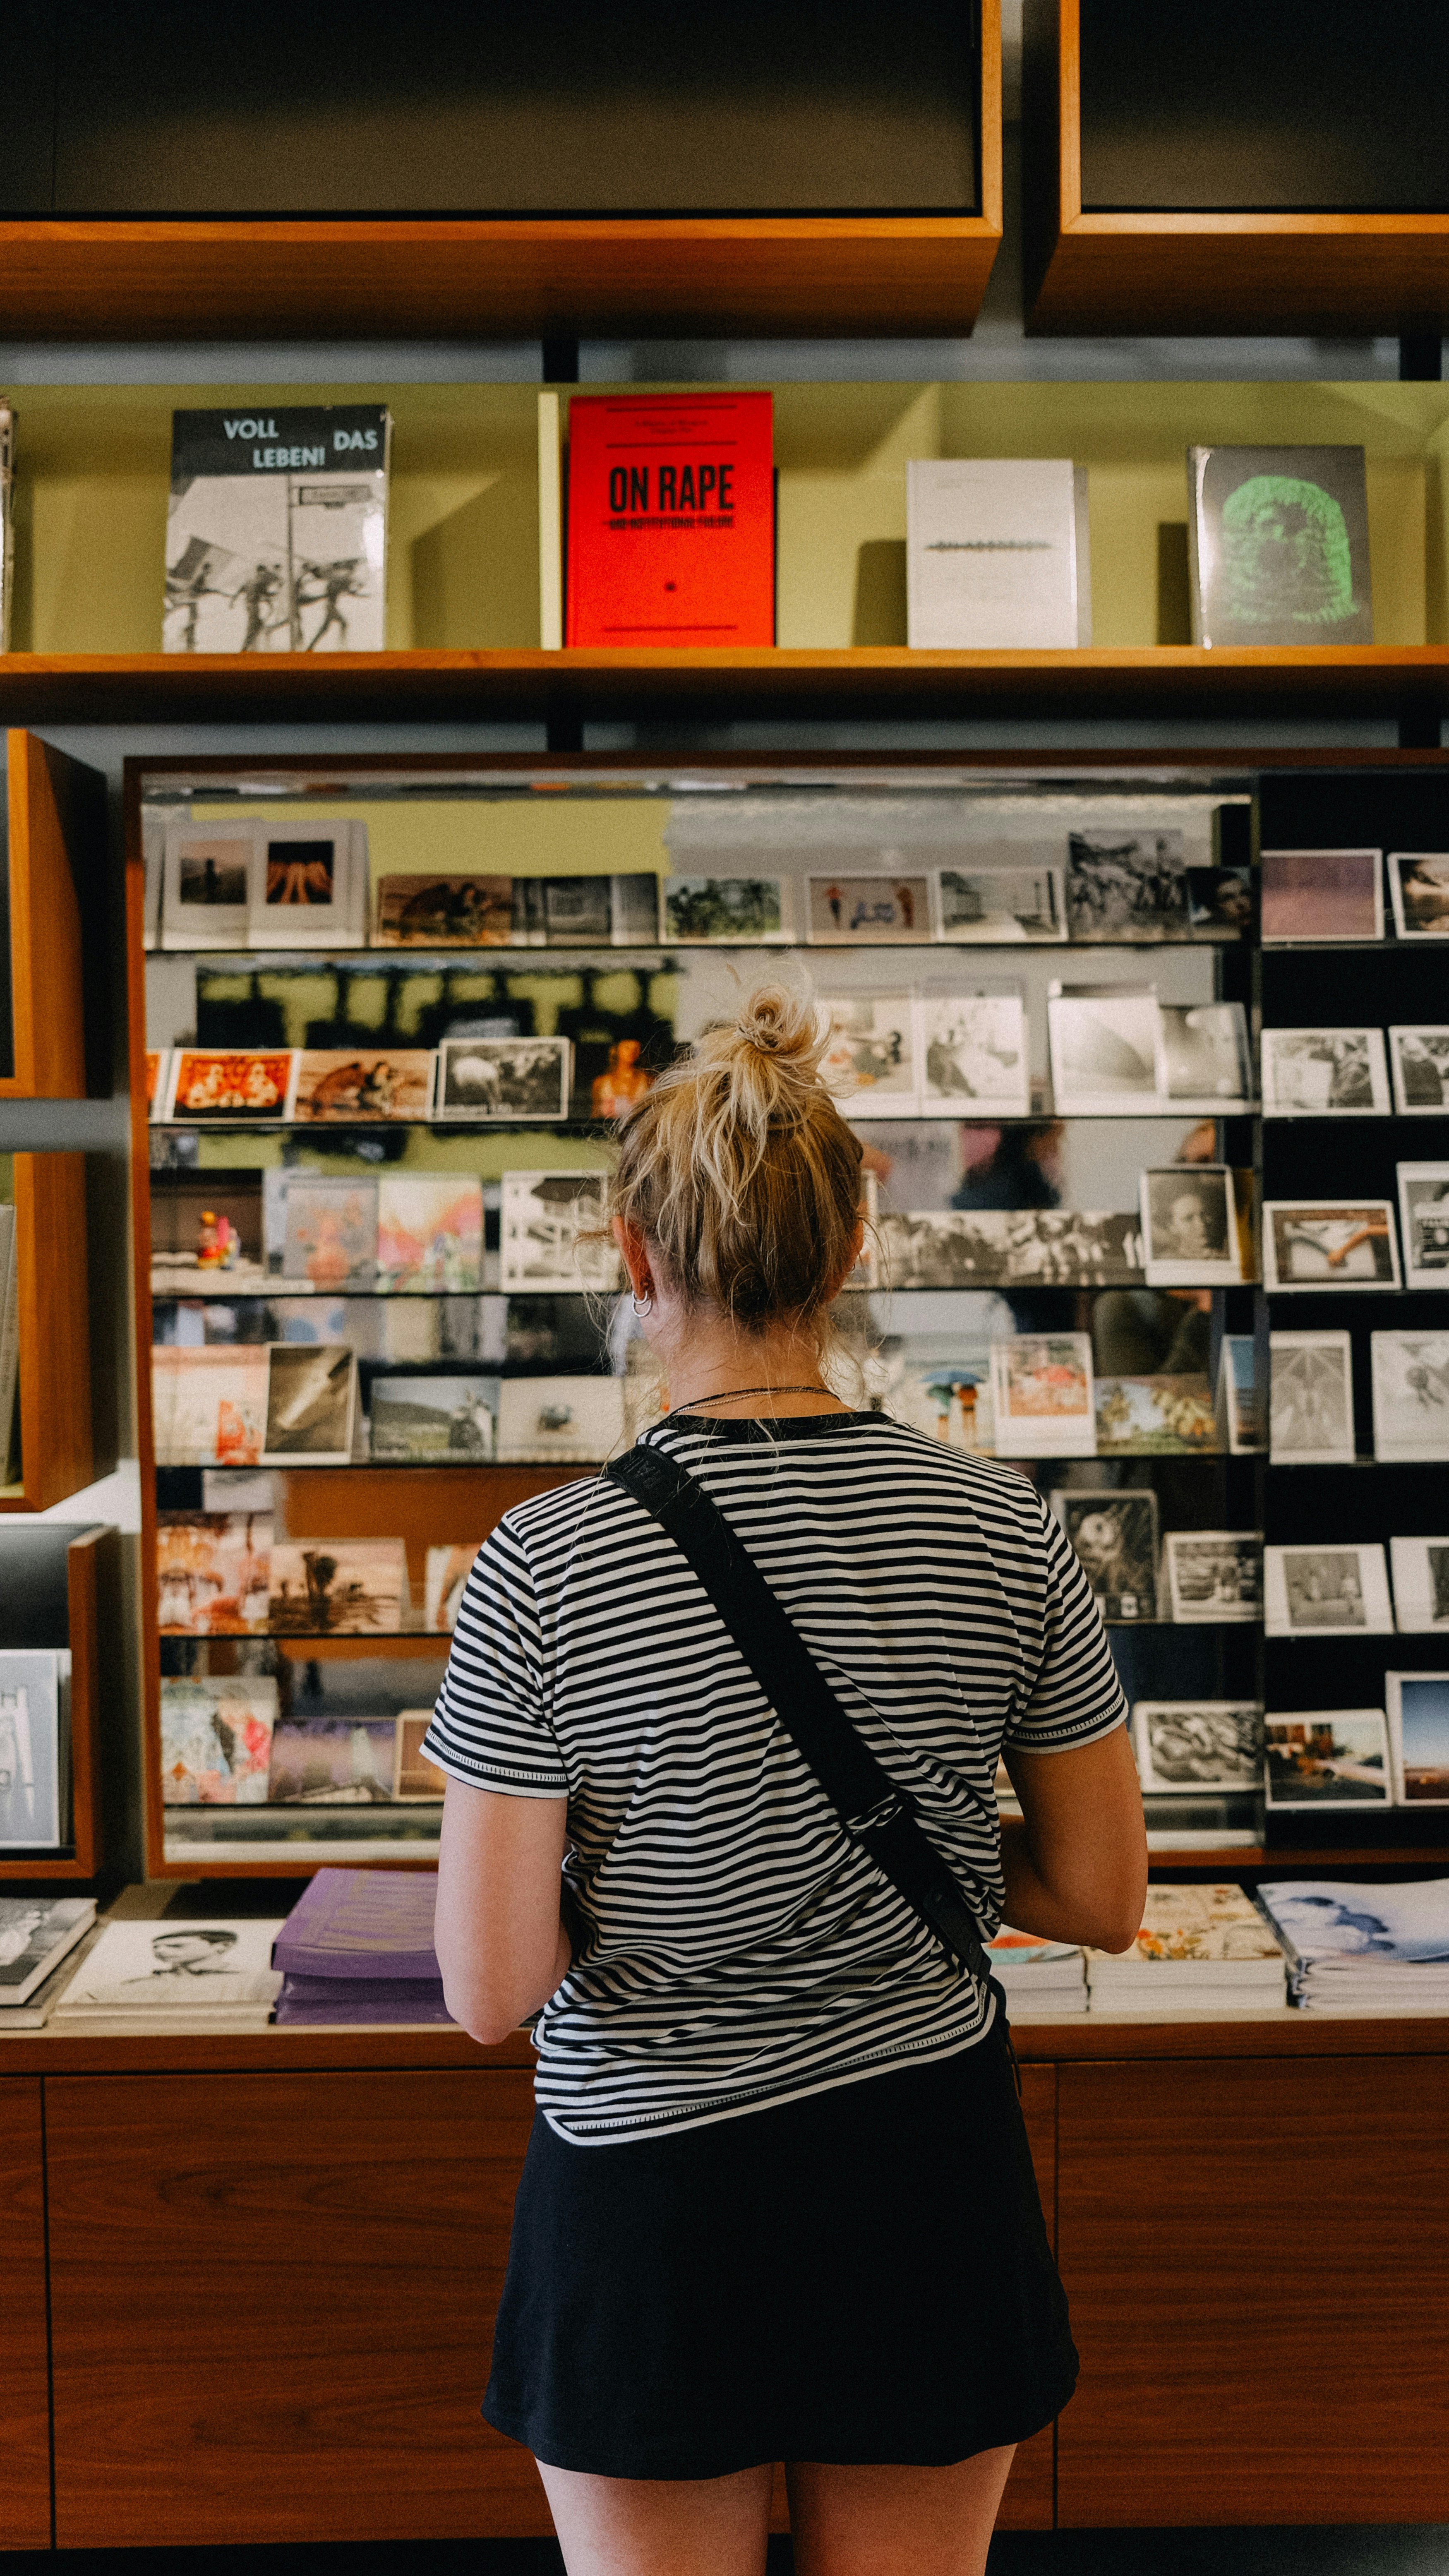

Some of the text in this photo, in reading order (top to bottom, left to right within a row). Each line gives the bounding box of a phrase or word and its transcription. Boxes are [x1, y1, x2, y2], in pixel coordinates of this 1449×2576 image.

[223, 419, 279, 439] VOLL
[333, 430, 378, 451] DAS
[253, 446, 326, 468] LEBEN!
[609, 464, 734, 513] ON RAPE
